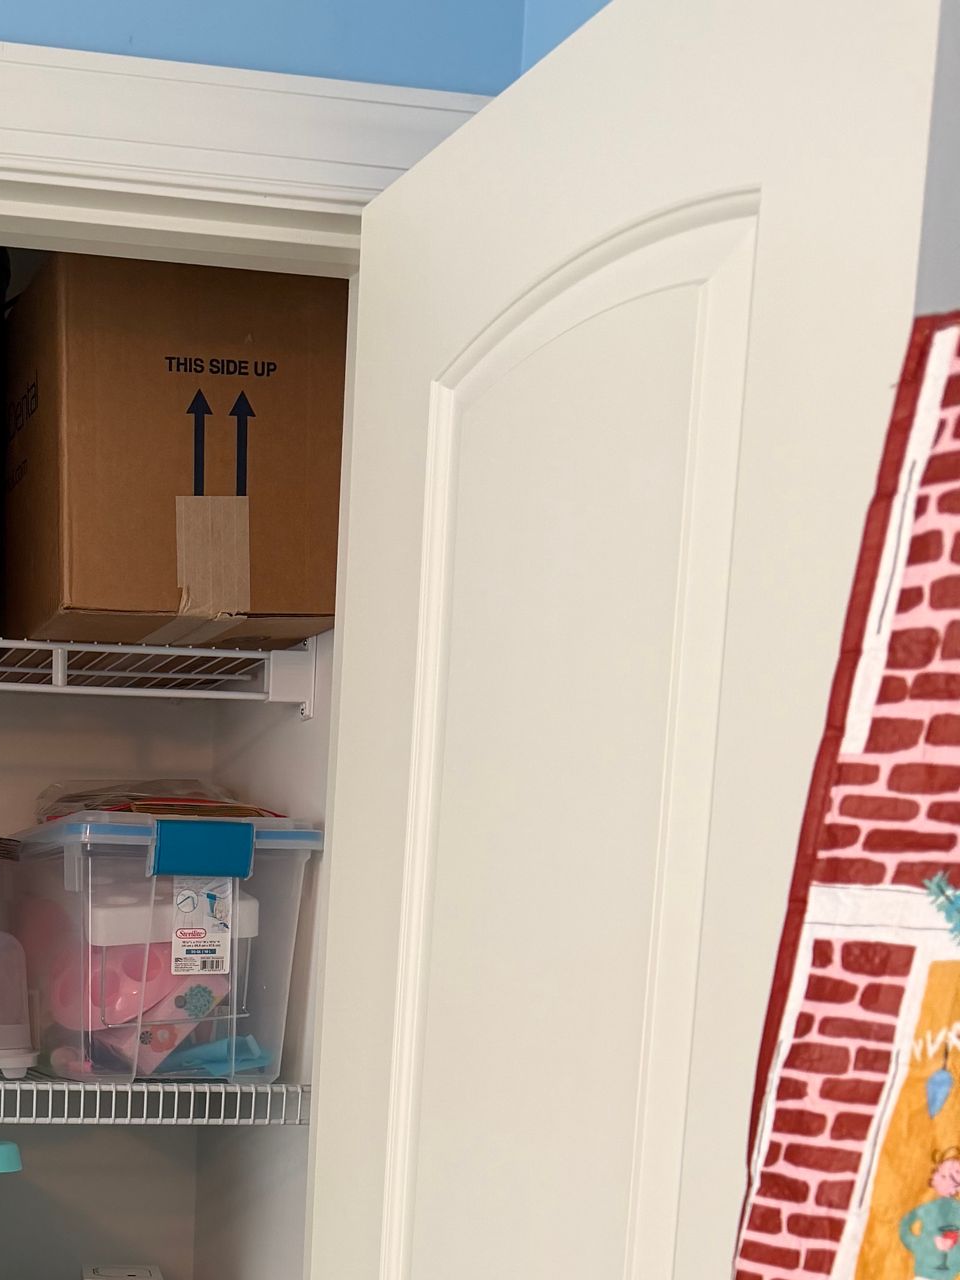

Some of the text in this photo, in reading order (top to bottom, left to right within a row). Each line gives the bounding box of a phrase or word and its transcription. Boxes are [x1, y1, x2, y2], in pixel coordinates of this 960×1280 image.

[165, 356, 277, 377] THIS SIDE UP
